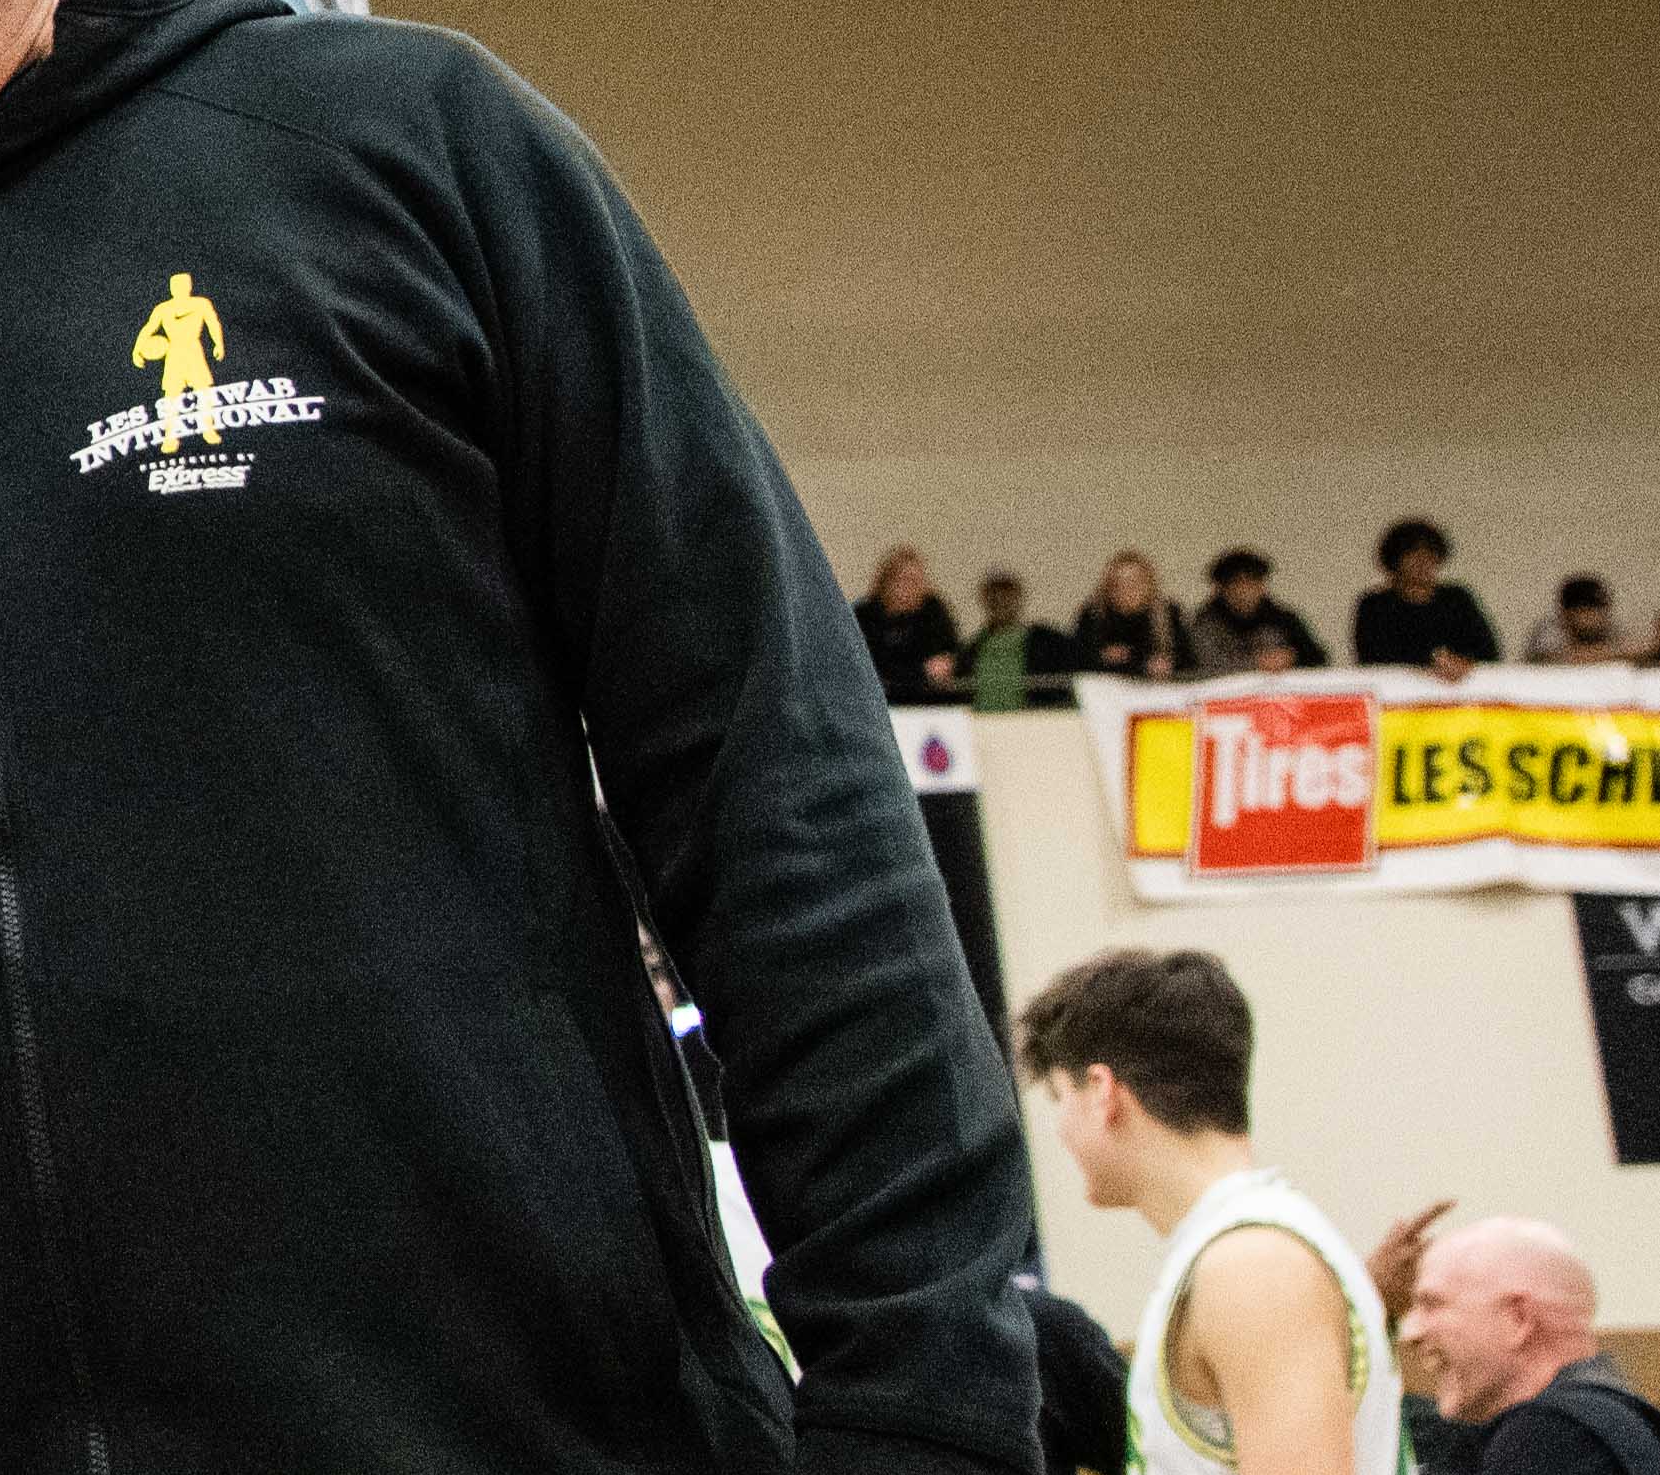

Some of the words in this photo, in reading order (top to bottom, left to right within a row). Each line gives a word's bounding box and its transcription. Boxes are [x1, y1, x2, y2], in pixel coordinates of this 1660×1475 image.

[70, 398, 324, 474] INVITATIONAL
[87, 405, 149, 445] LES
[155, 377, 297, 419] SCHWAB
[1203, 714, 1370, 829] Tires
[1391, 737, 1494, 807] LES
[1505, 736, 1660, 807] SCH
